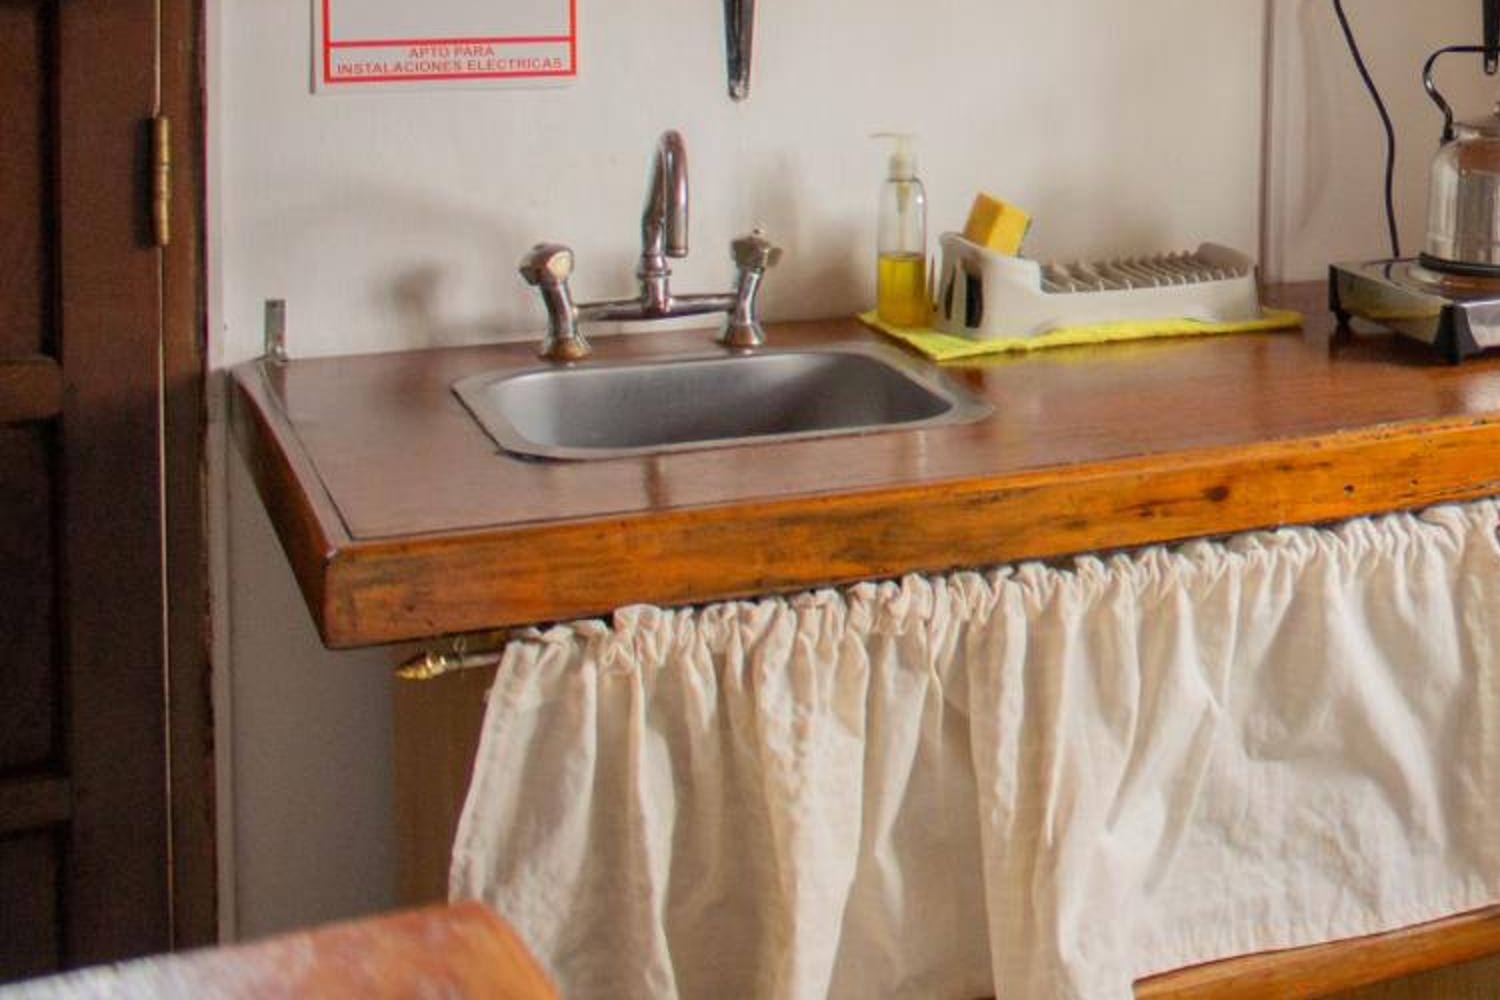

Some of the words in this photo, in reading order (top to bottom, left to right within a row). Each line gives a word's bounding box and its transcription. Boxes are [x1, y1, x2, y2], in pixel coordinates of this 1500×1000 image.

[407, 47, 448, 59] APTO
[454, 45, 496, 57] PARA
[336, 60, 462, 75] INSTALACIONES
